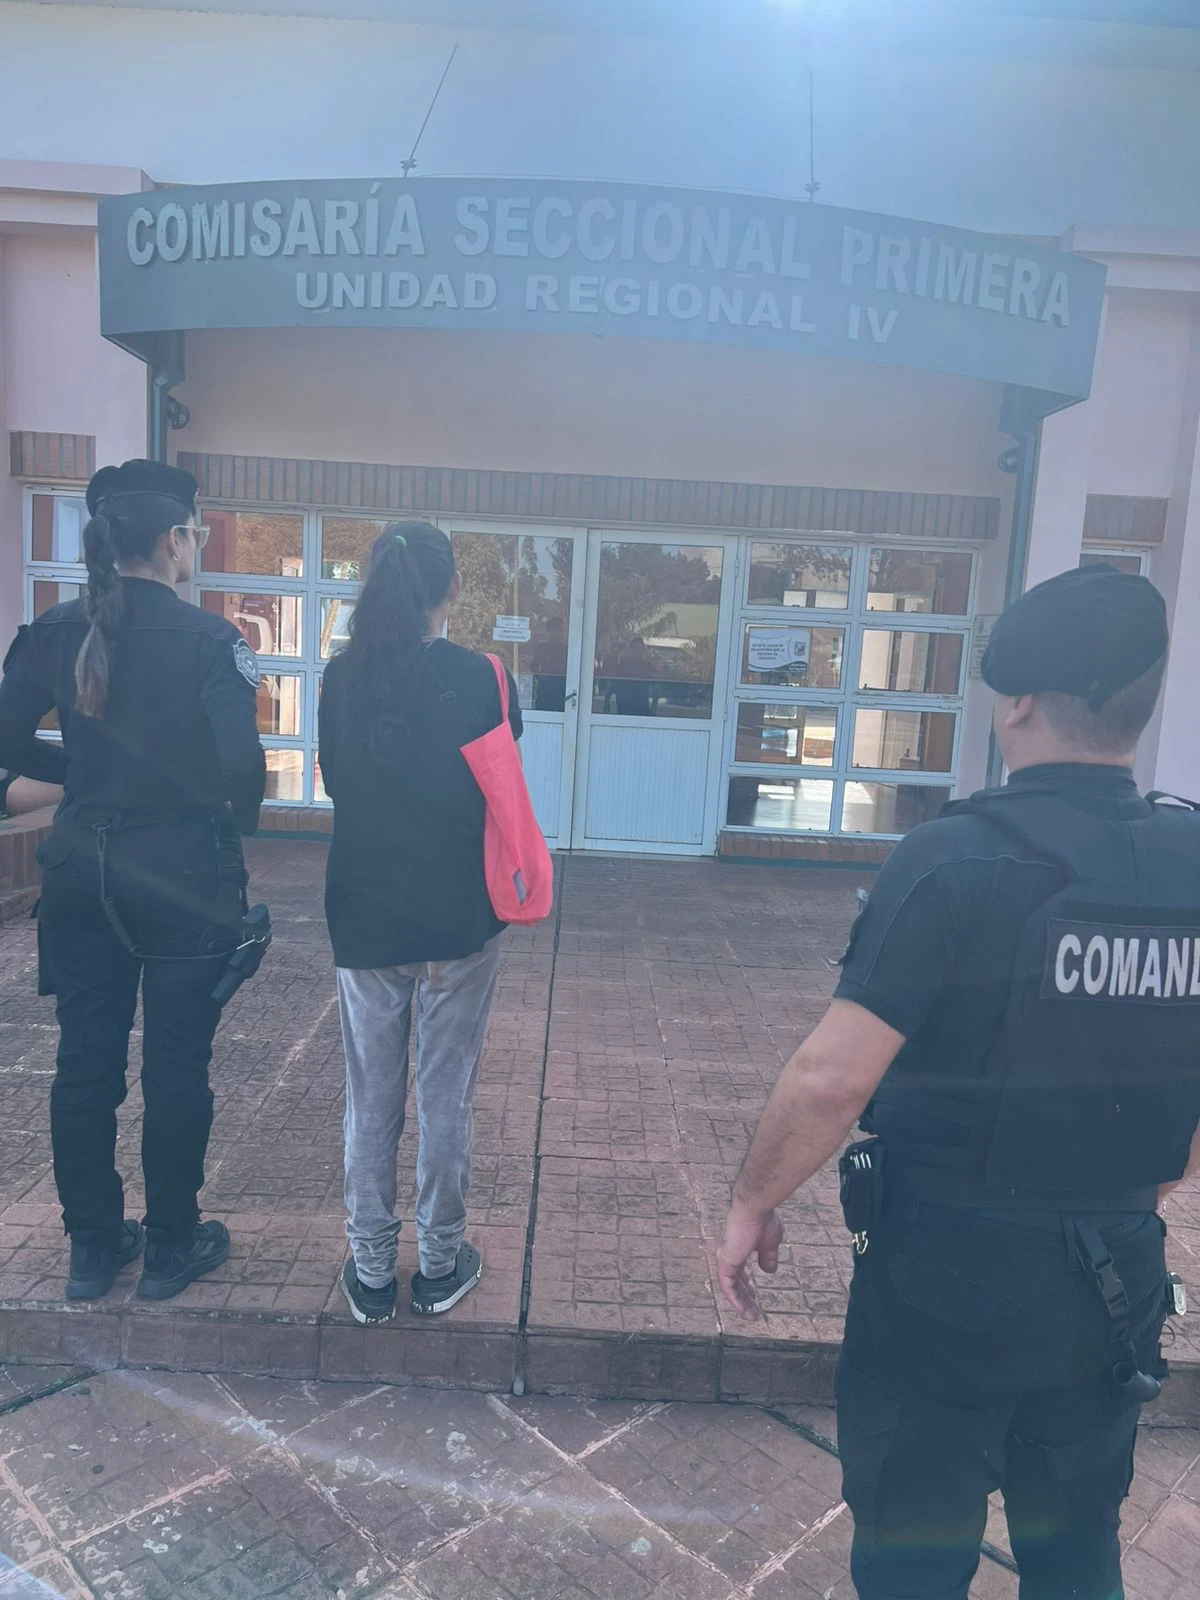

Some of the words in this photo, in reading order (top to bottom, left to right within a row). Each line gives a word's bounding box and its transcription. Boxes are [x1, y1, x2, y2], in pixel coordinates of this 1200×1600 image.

[126, 182, 425, 267] COMISARÍA
[455, 193, 811, 280] SECCIONAL
[840, 225, 1072, 327] PRIMERA
[295, 271, 498, 310] UNIDAD
[525, 273, 817, 333] REGIONAL
[847, 304, 899, 345] IV
